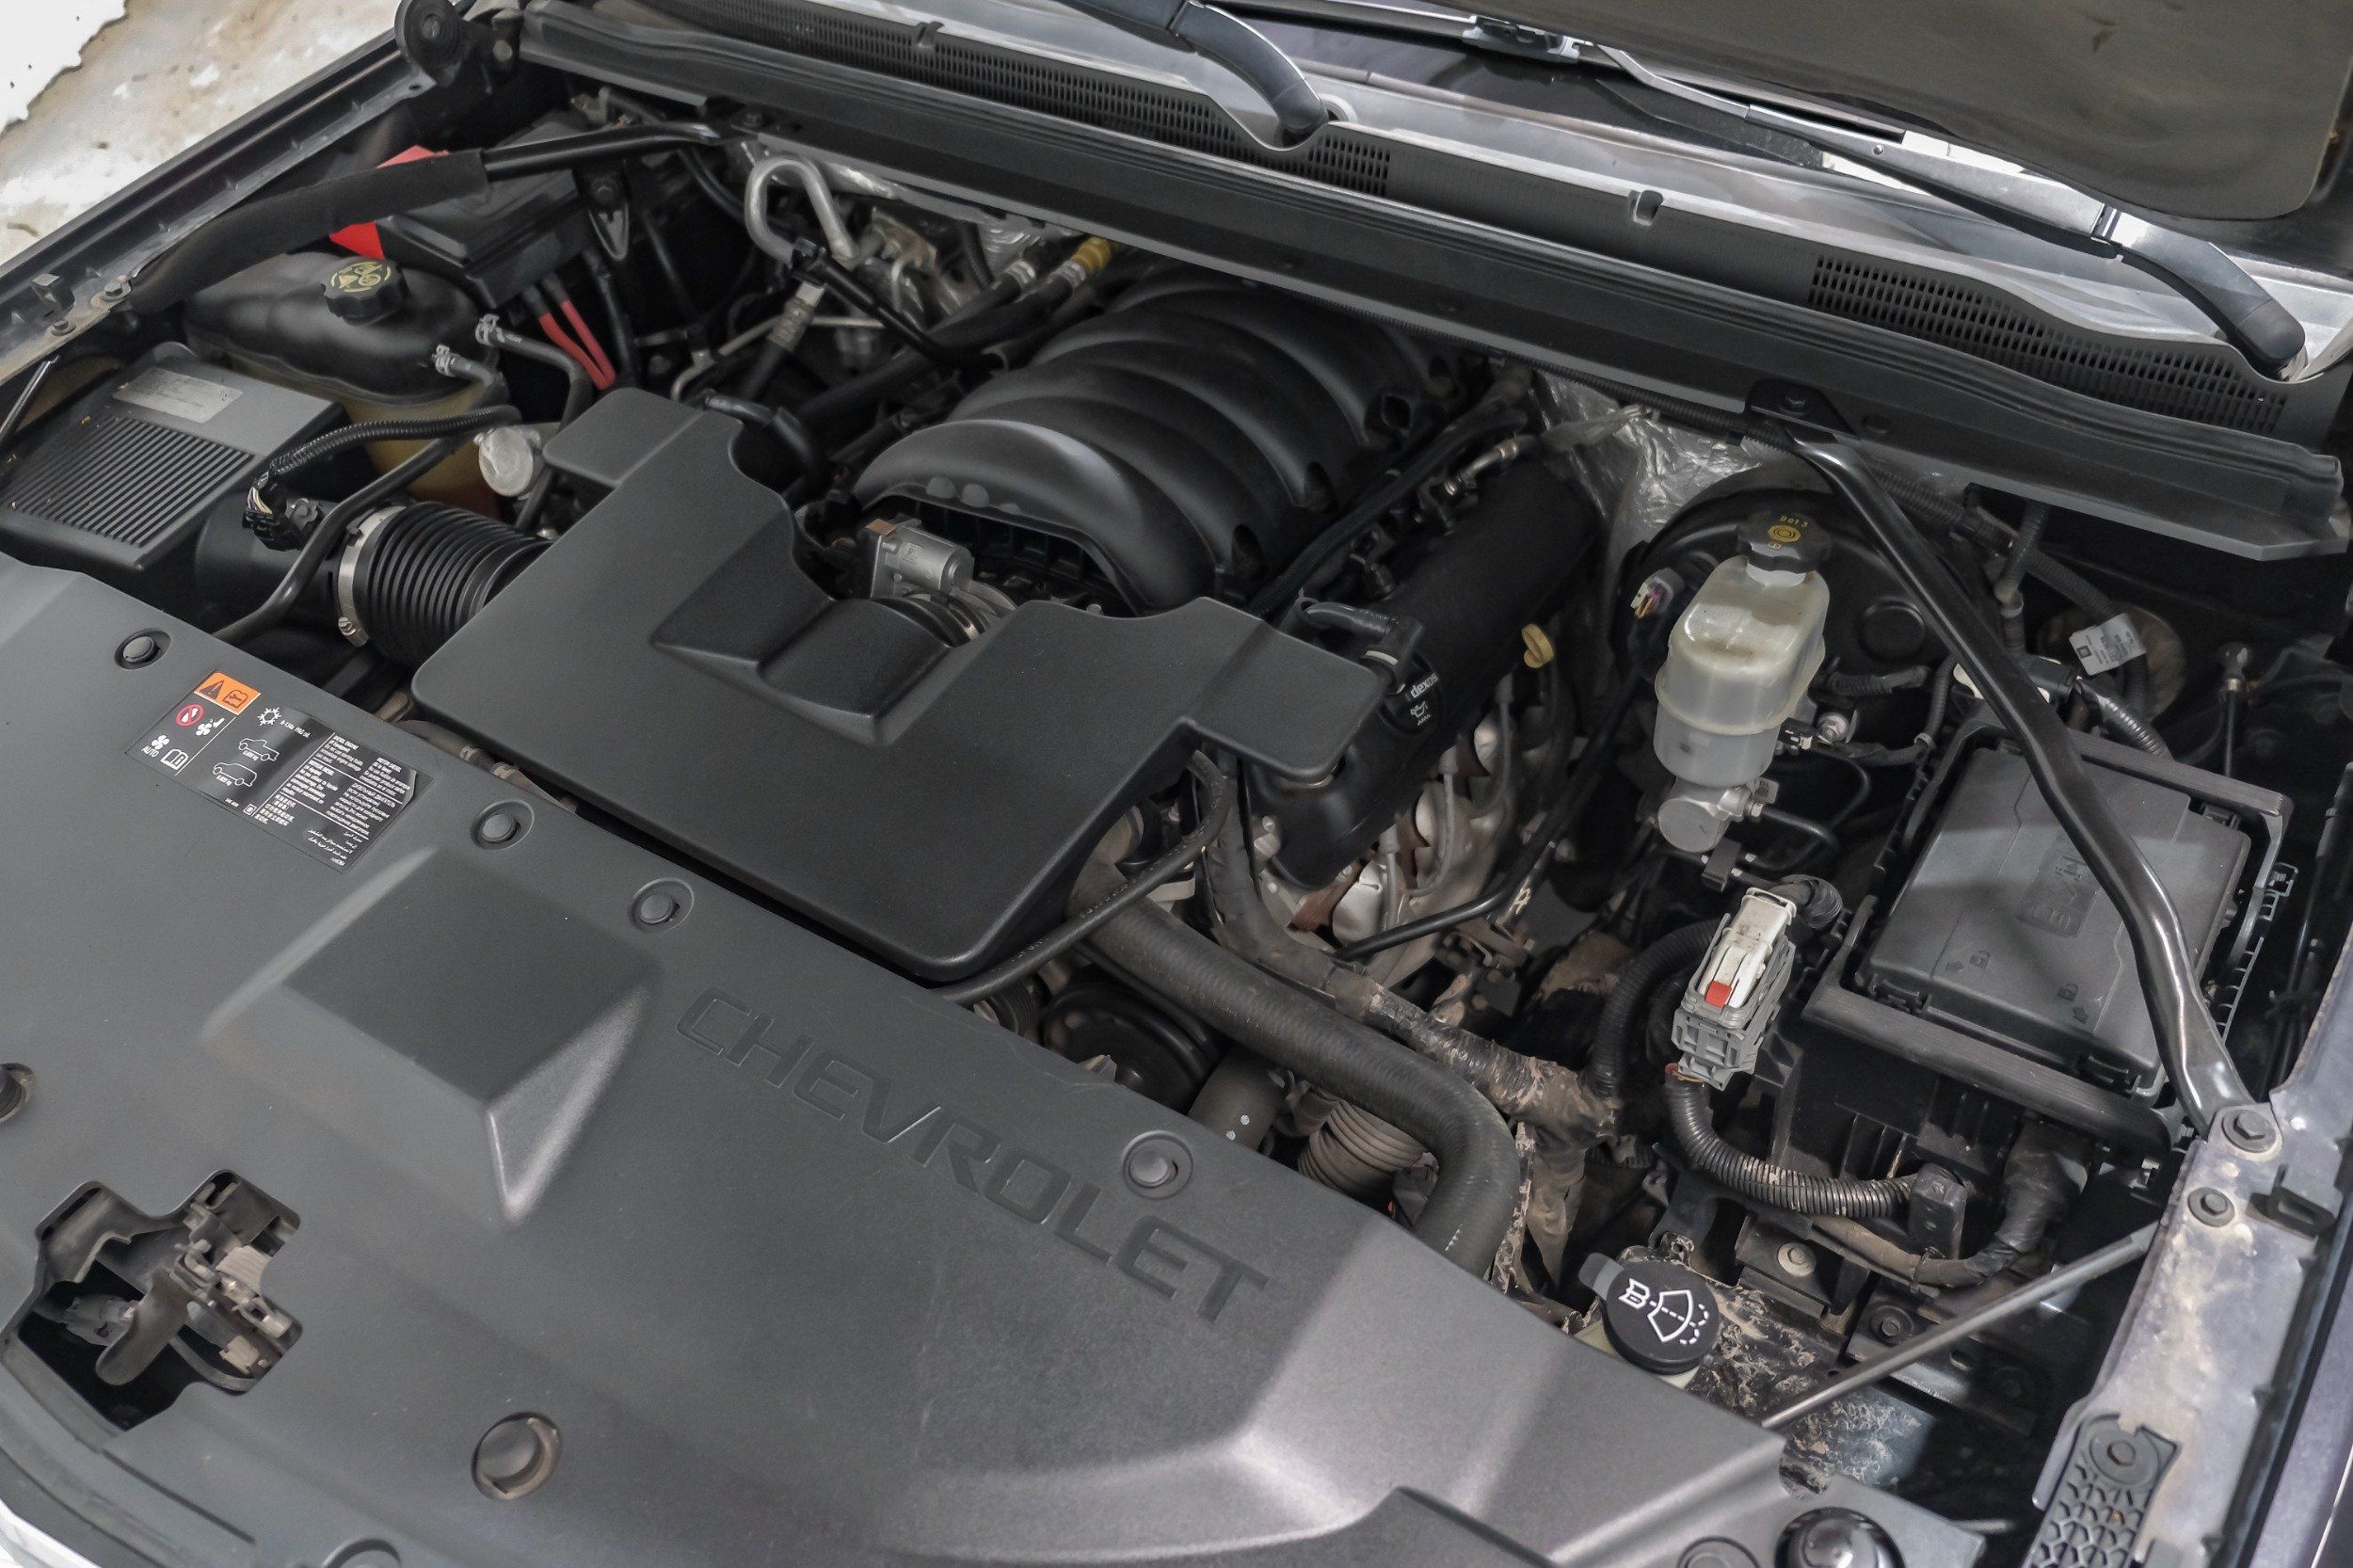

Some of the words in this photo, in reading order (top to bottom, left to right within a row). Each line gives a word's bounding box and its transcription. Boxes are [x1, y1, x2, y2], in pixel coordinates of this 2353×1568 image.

[1410, 673, 1438, 698] dexos
[141, 745, 160, 758] AUTO
[676, 987, 1270, 1324] CHEVROLET
